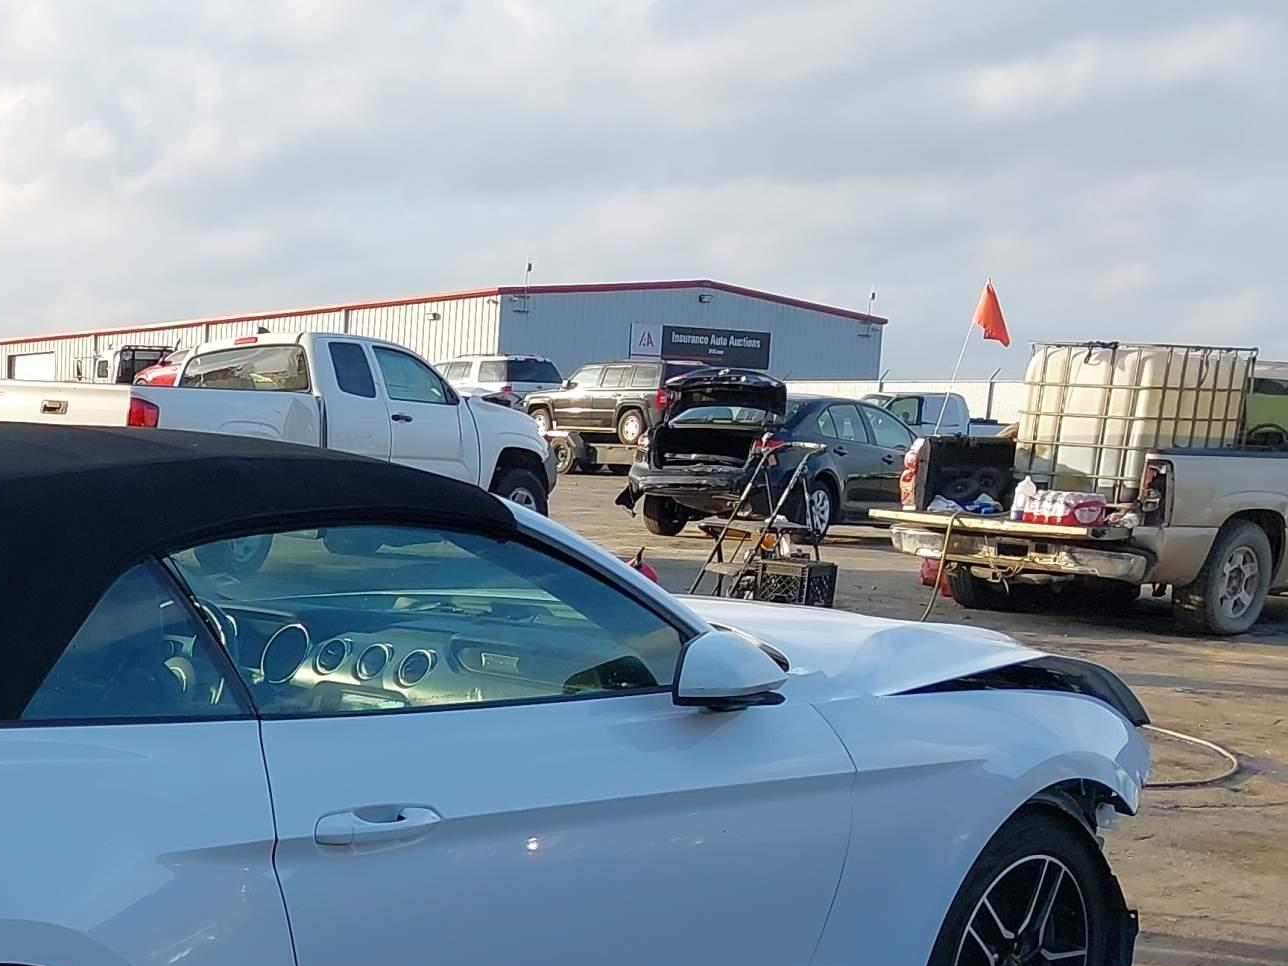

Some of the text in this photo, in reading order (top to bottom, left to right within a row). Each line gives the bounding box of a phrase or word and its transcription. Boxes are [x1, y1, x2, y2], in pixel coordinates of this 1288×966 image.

[671, 330, 761, 349] Insurance Auto Auctions
